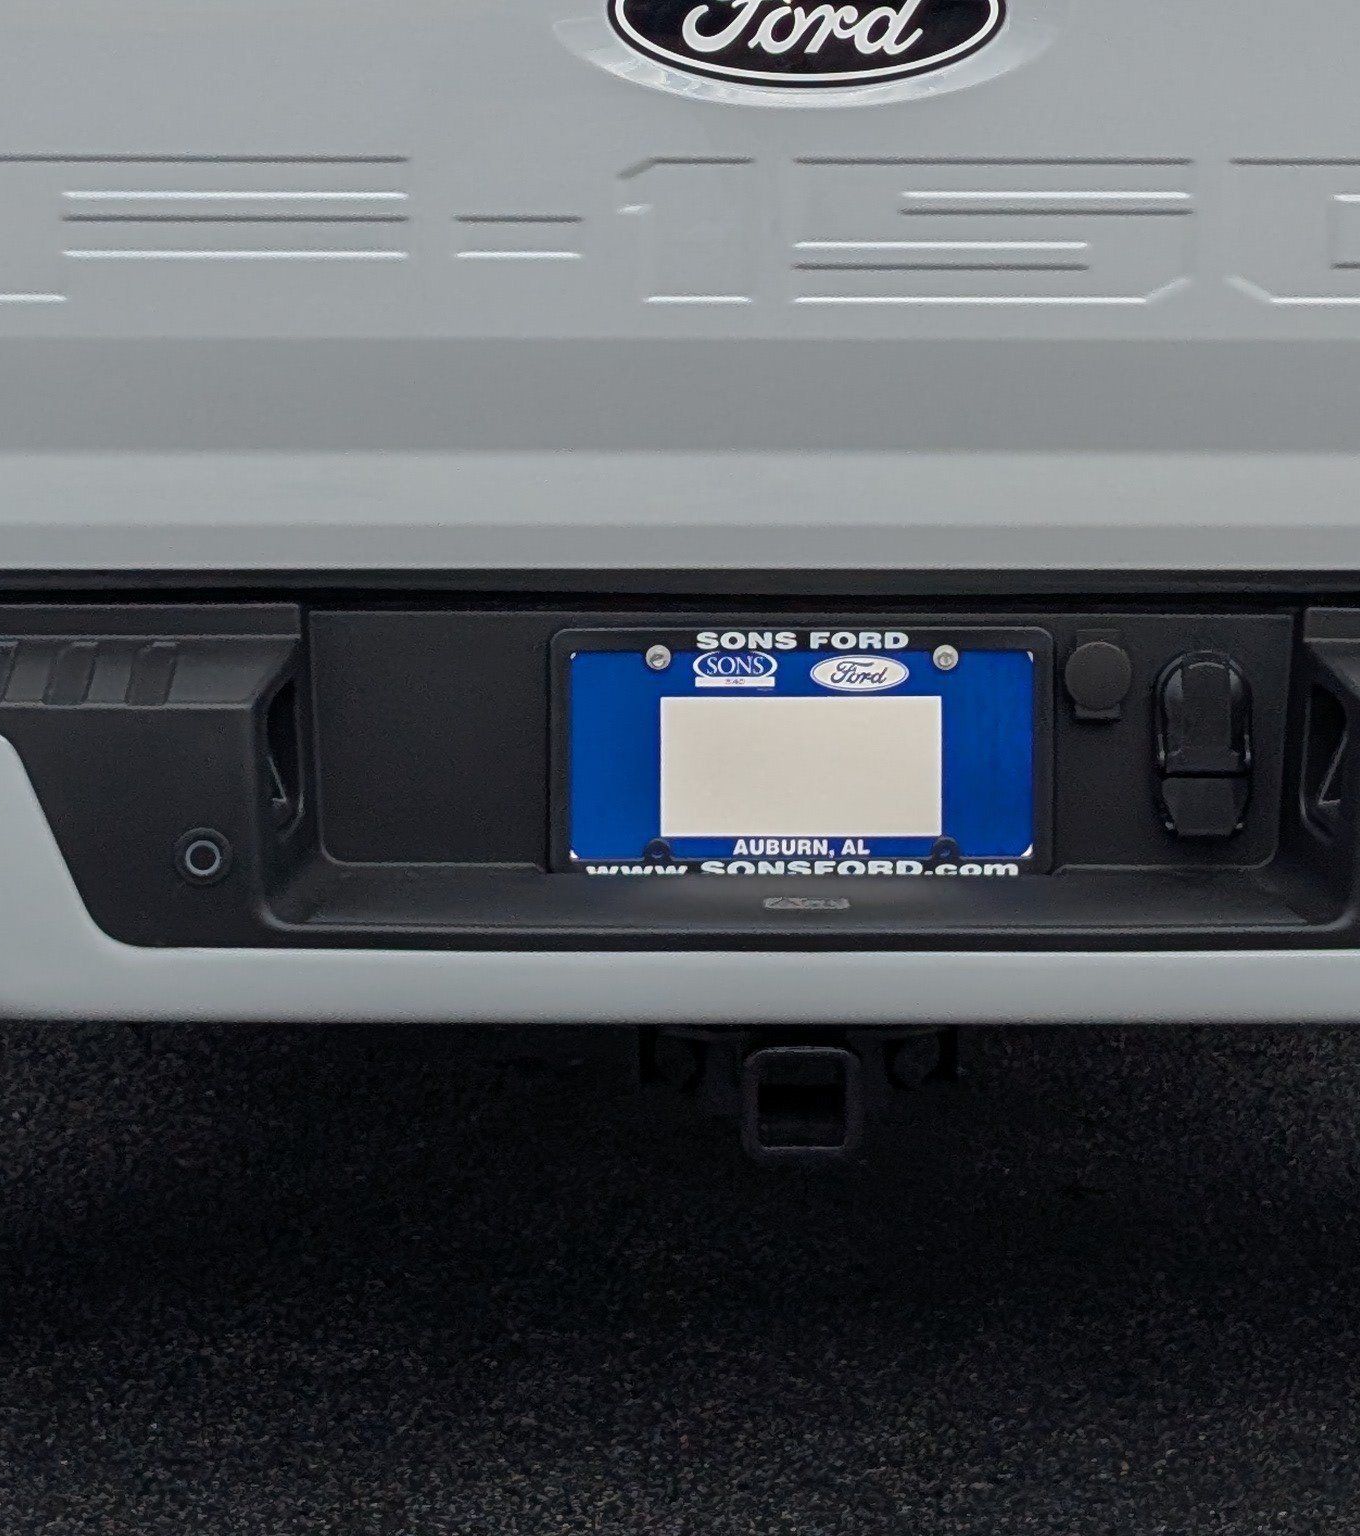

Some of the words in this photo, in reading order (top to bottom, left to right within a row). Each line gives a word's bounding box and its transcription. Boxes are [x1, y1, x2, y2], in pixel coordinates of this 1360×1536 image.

[696, 631, 798, 650] SONS
[809, 631, 909, 650] FORD
[705, 656, 765, 676] SONS
[830, 660, 889, 685] Ford
[733, 839, 836, 859] AUBURN,
[840, 839, 871, 856] AL
